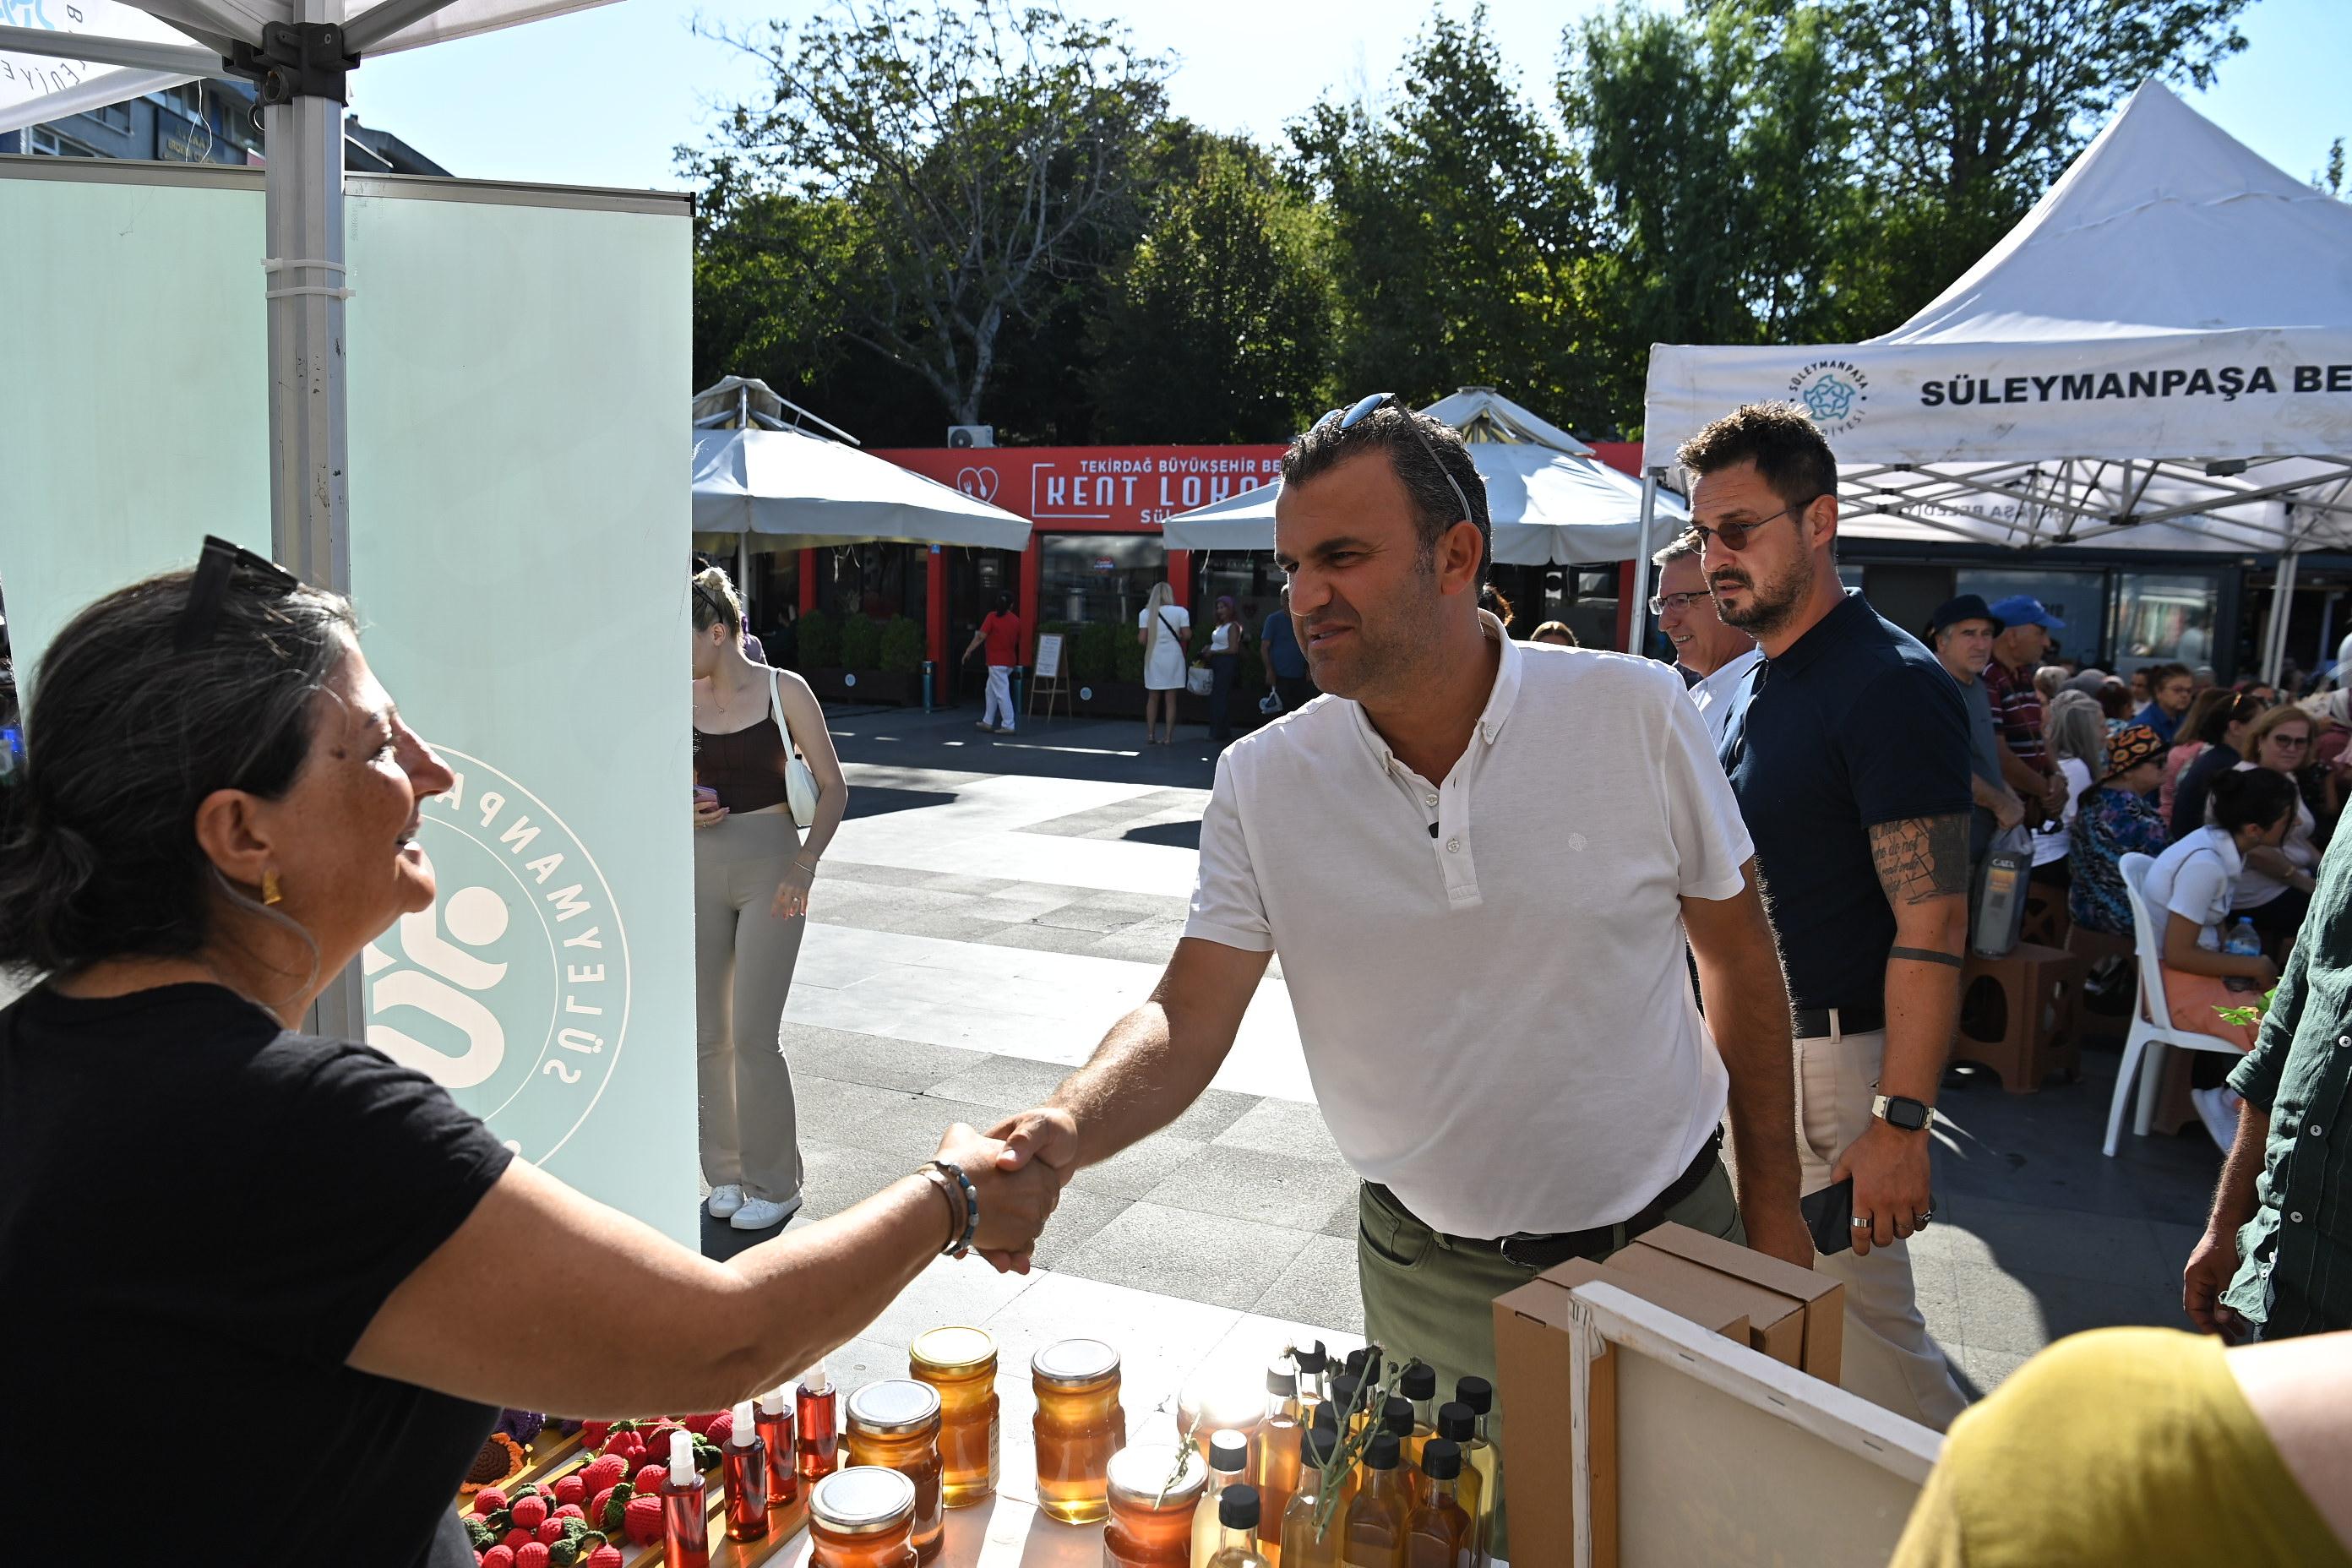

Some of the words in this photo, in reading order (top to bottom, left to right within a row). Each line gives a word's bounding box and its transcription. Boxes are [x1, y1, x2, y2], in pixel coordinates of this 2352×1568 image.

[1788, 360, 1869, 392] SÜLEYMANPAŞA
[1920, 366, 2278, 407] SÜLEYMANPAŞA
[2294, 364, 2352, 394] BE
[1080, 457, 1152, 473] TEKİRDAĞ
[1158, 456, 1256, 474] BÜYÜKŞEHİR
[1047, 476, 1138, 506] KENT
